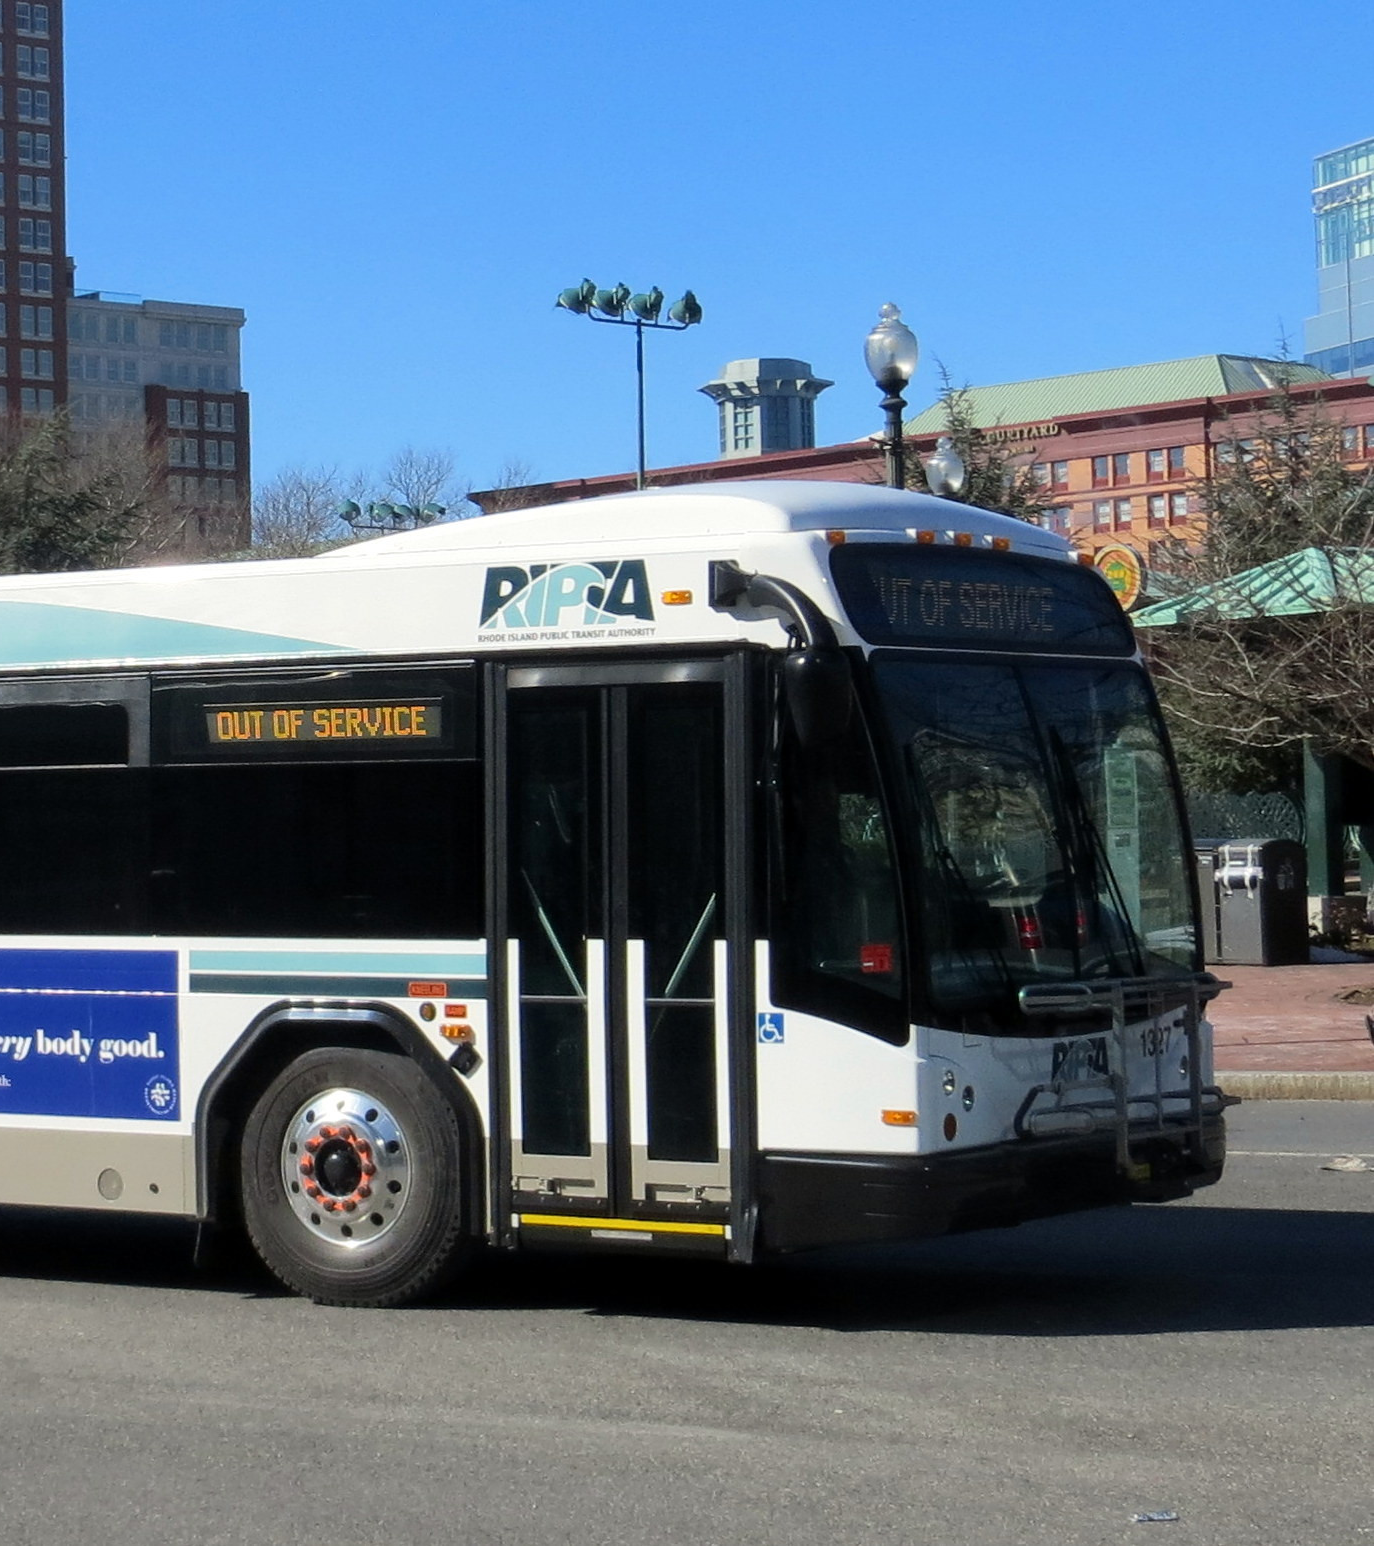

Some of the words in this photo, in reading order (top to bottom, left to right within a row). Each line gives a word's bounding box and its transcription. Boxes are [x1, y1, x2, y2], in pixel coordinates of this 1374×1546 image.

[478, 559, 656, 629] RIPTA
[920, 579, 952, 626] OF
[958, 581, 1055, 632] SERVICE
[477, 632, 506, 643] RHODE
[507, 631, 538, 642] ISLAND
[539, 630, 569, 641] PUBLIC
[571, 629, 605, 639] TRANSIT
[607, 627, 656, 638] AUTHORITY
[217, 710, 264, 740] OUT
[273, 709, 304, 739] OF
[313, 706, 426, 738] SERVICE
[36, 1028, 93, 1063] body
[99, 1031, 165, 1064] good.
